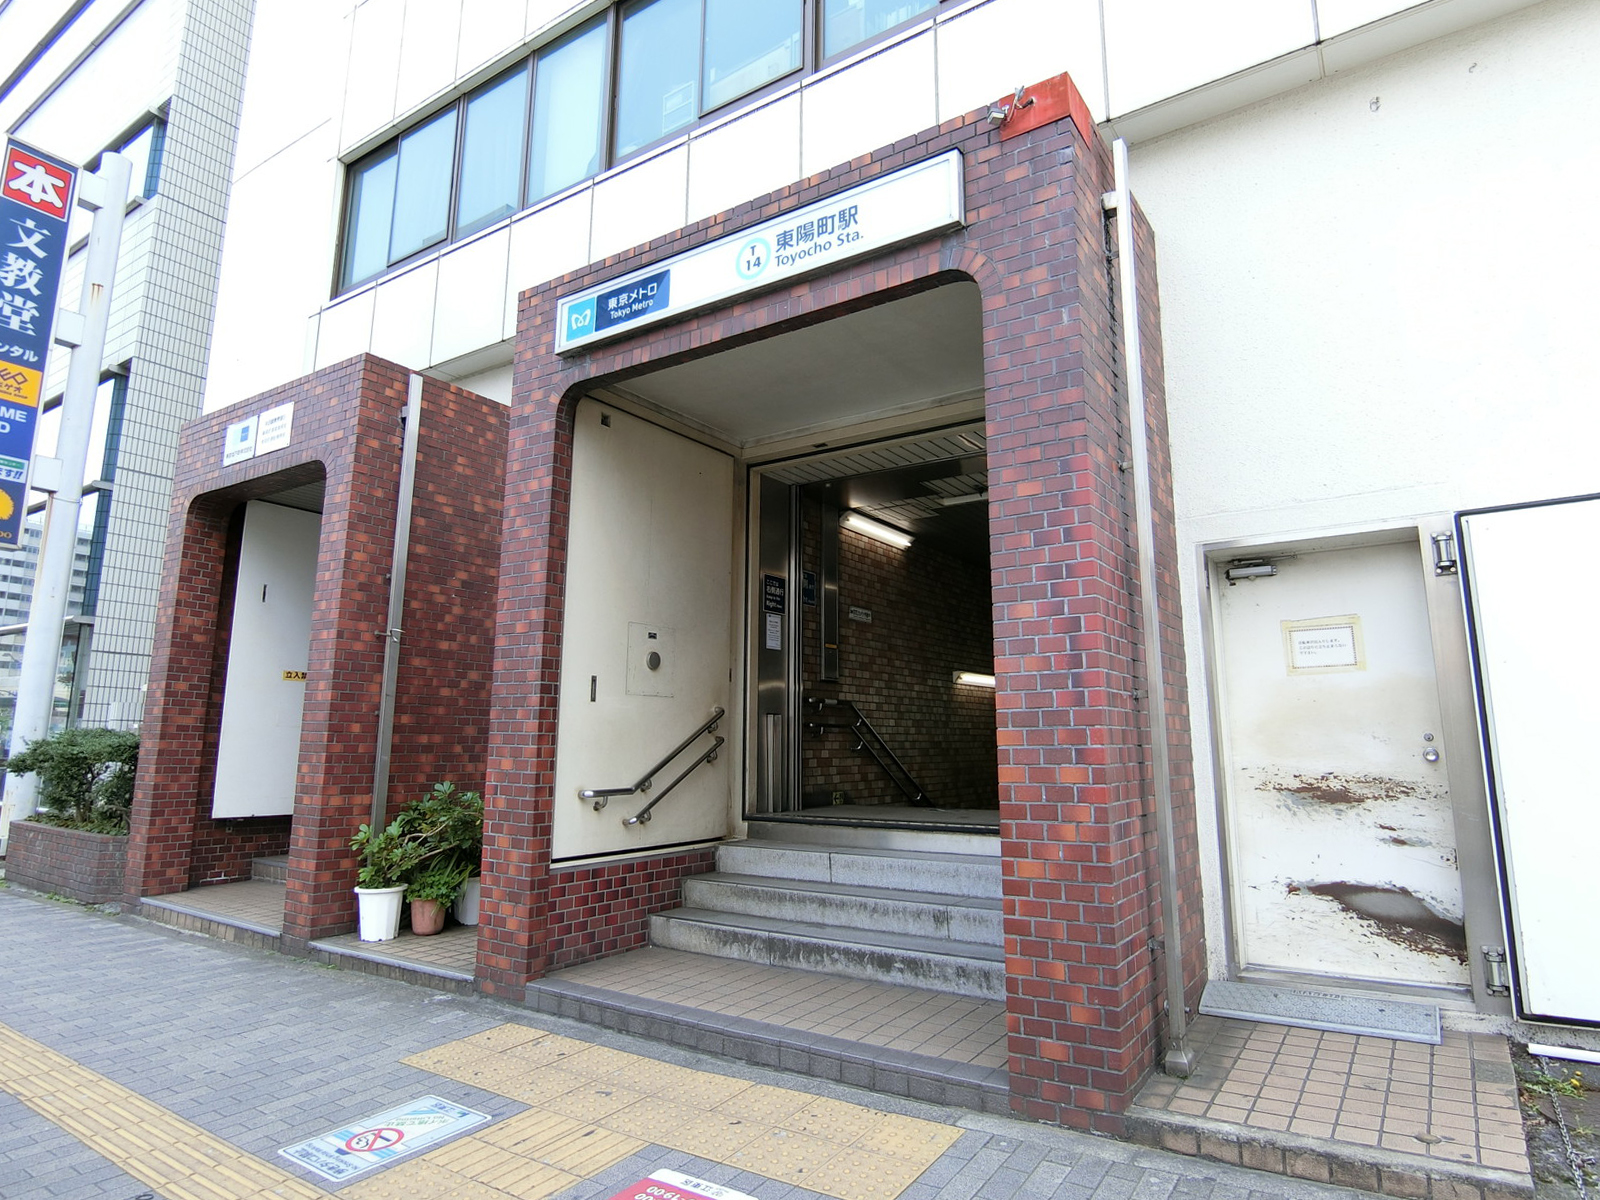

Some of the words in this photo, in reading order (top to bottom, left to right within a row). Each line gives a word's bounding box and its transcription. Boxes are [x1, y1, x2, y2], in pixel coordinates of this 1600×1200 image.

[8, 164, 66, 208] 本
[775, 204, 858, 253] 東陽町駅
[746, 256, 762, 271] 14
[750, 245, 757, 256] T
[775, 241, 832, 267] Toyocho
[837, 231, 864, 247] Sta.
[0, 217, 51, 337] 文教堂
[607, 282, 657, 311] 東京メトロ
[610, 307, 631, 320] Tokyo
[631, 299, 654, 313] Metro
